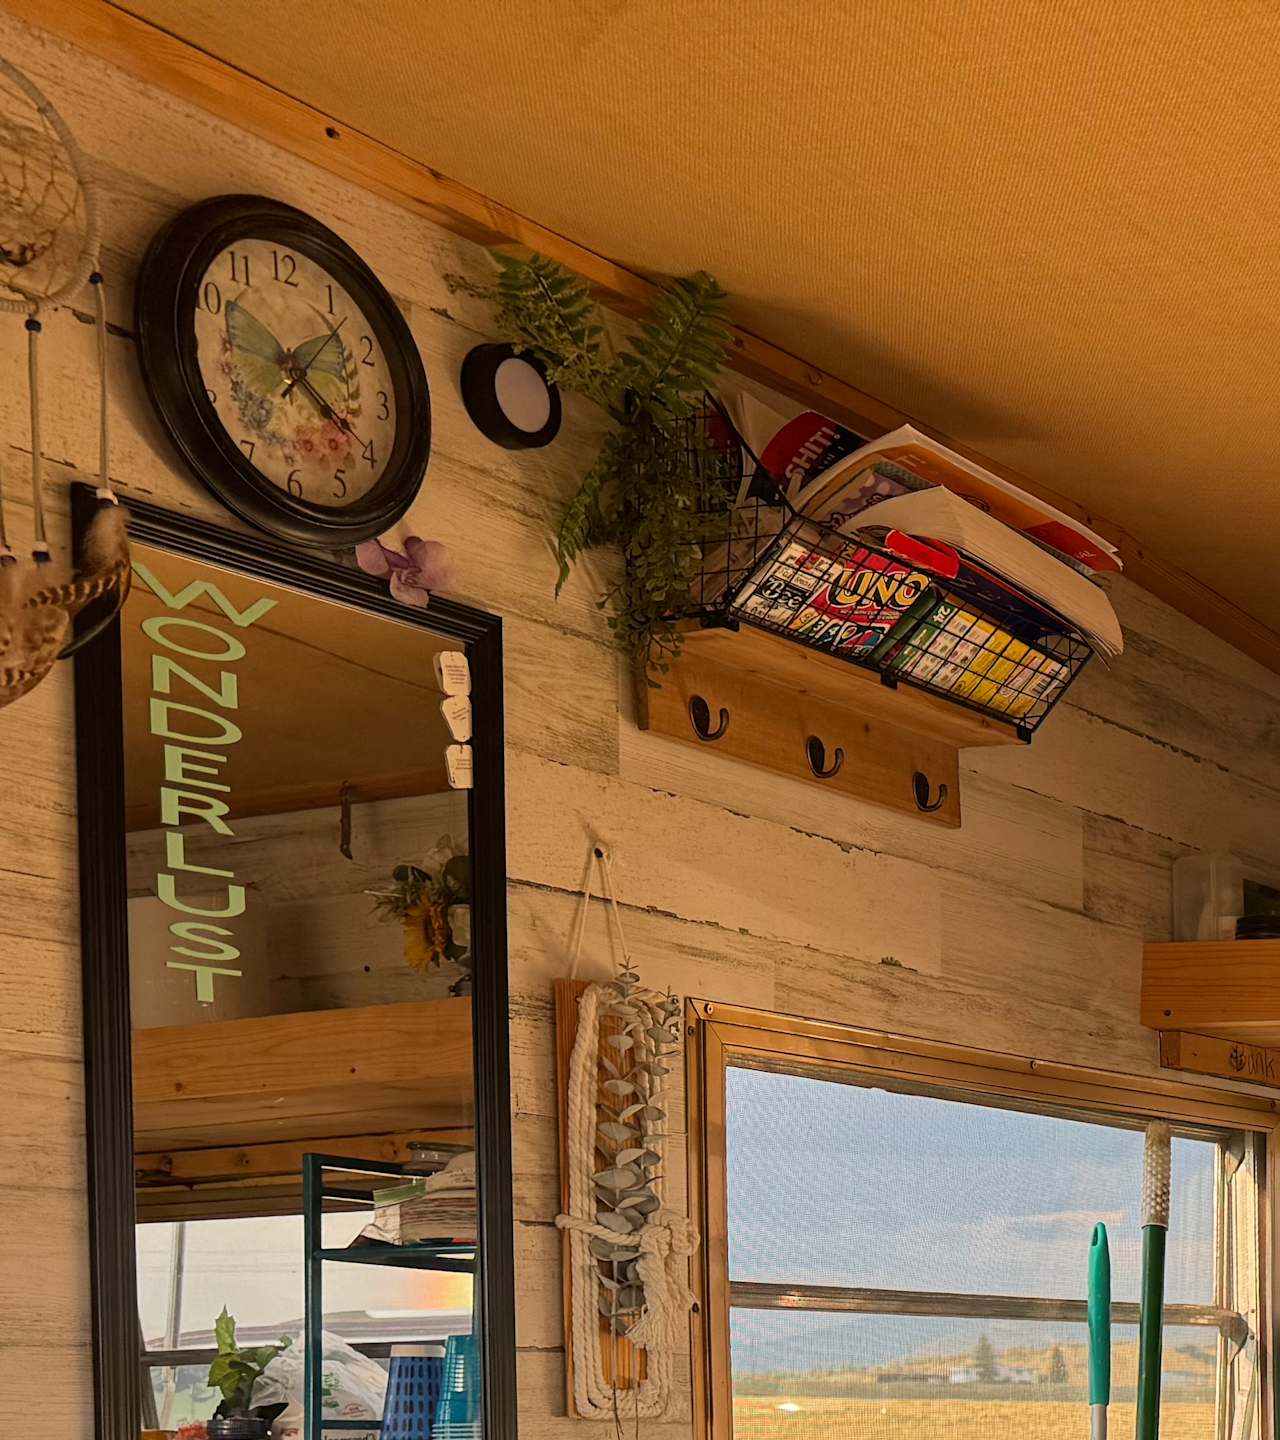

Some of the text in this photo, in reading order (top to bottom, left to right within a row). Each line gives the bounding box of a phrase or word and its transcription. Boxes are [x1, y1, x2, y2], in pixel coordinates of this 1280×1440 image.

[229, 251, 253, 288] 11
[271, 250, 300, 288] 12
[325, 284, 336, 316] 1
[360, 335, 376, 367] 2
[376, 391, 390, 421] 3
[361, 439, 378, 470] 4
[333, 468, 347, 498] 5
[828, 568, 933, 610] UNO
[129, 562, 279, 1003] WONDERLUST
